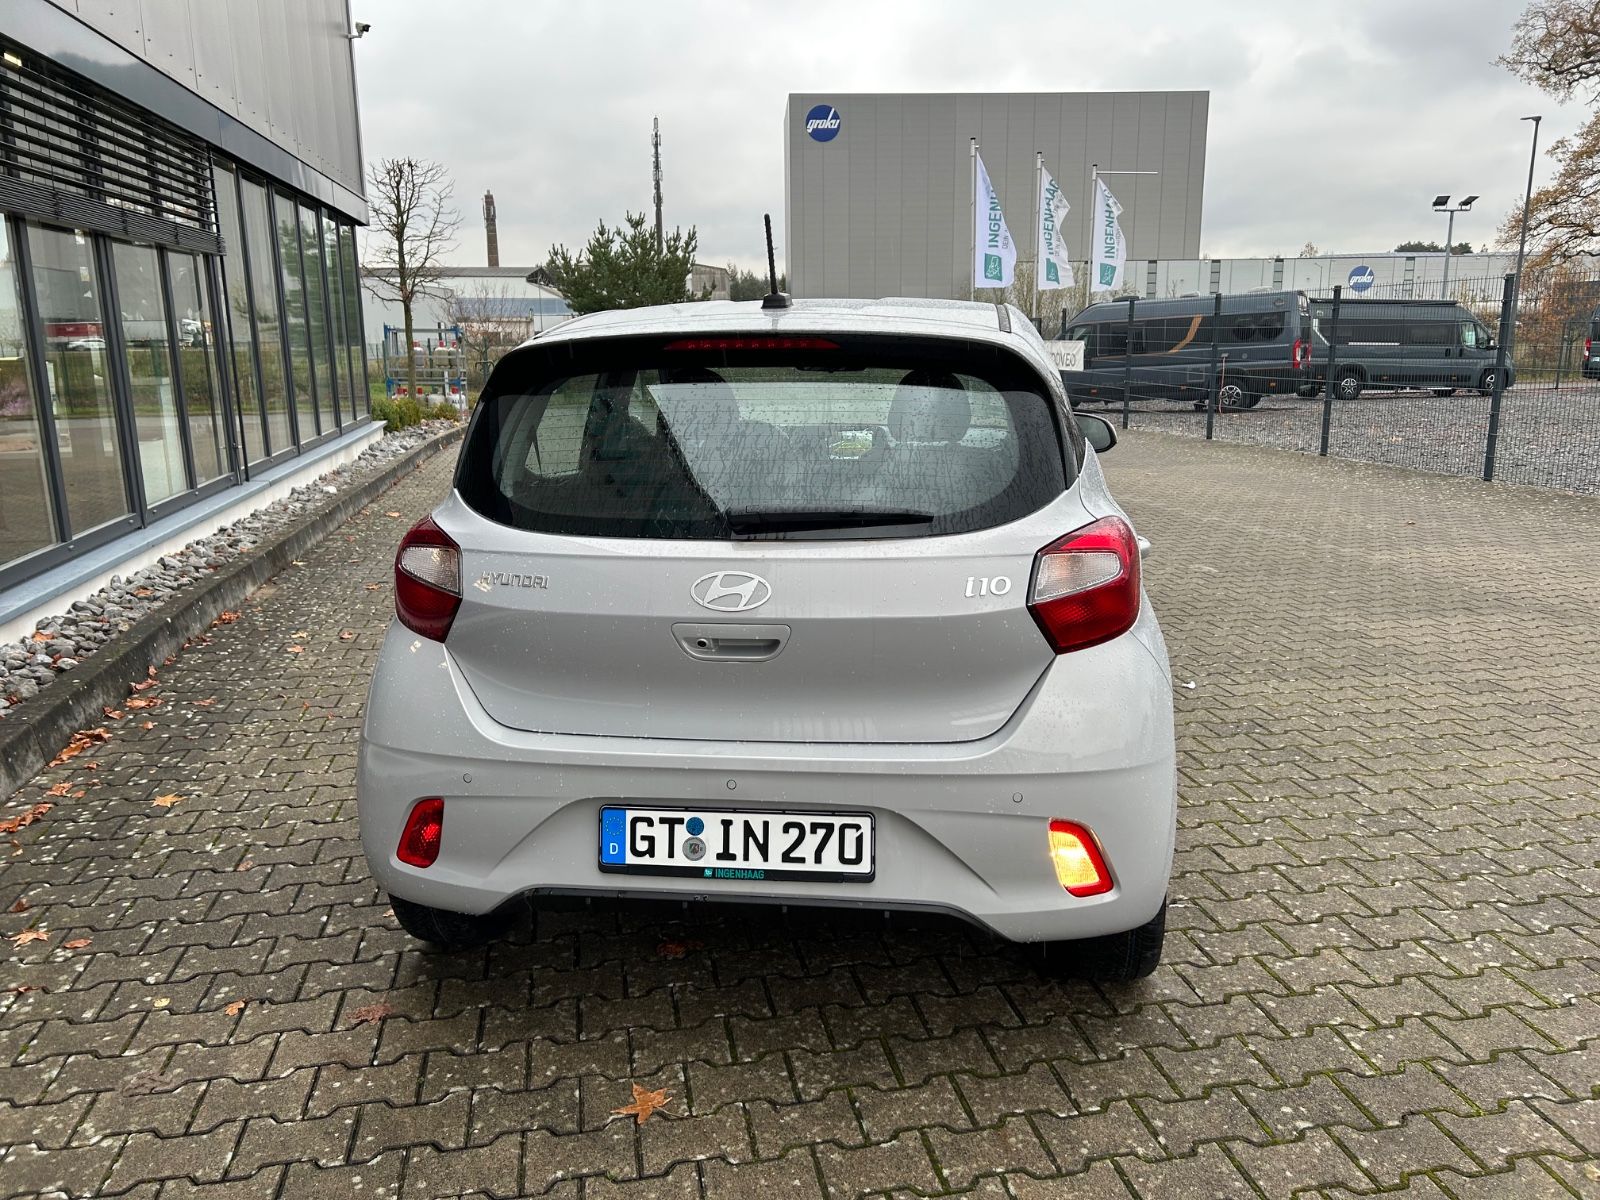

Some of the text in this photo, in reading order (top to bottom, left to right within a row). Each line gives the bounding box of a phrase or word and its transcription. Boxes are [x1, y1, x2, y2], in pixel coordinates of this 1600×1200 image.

[807, 107, 840, 121] groku
[480, 571, 549, 590] HYUNDAI
[965, 576, 1012, 597] i10
[609, 843, 619, 855] D
[629, 816, 864, 866] GT IN 270
[715, 868, 765, 880] INGENHAAG
